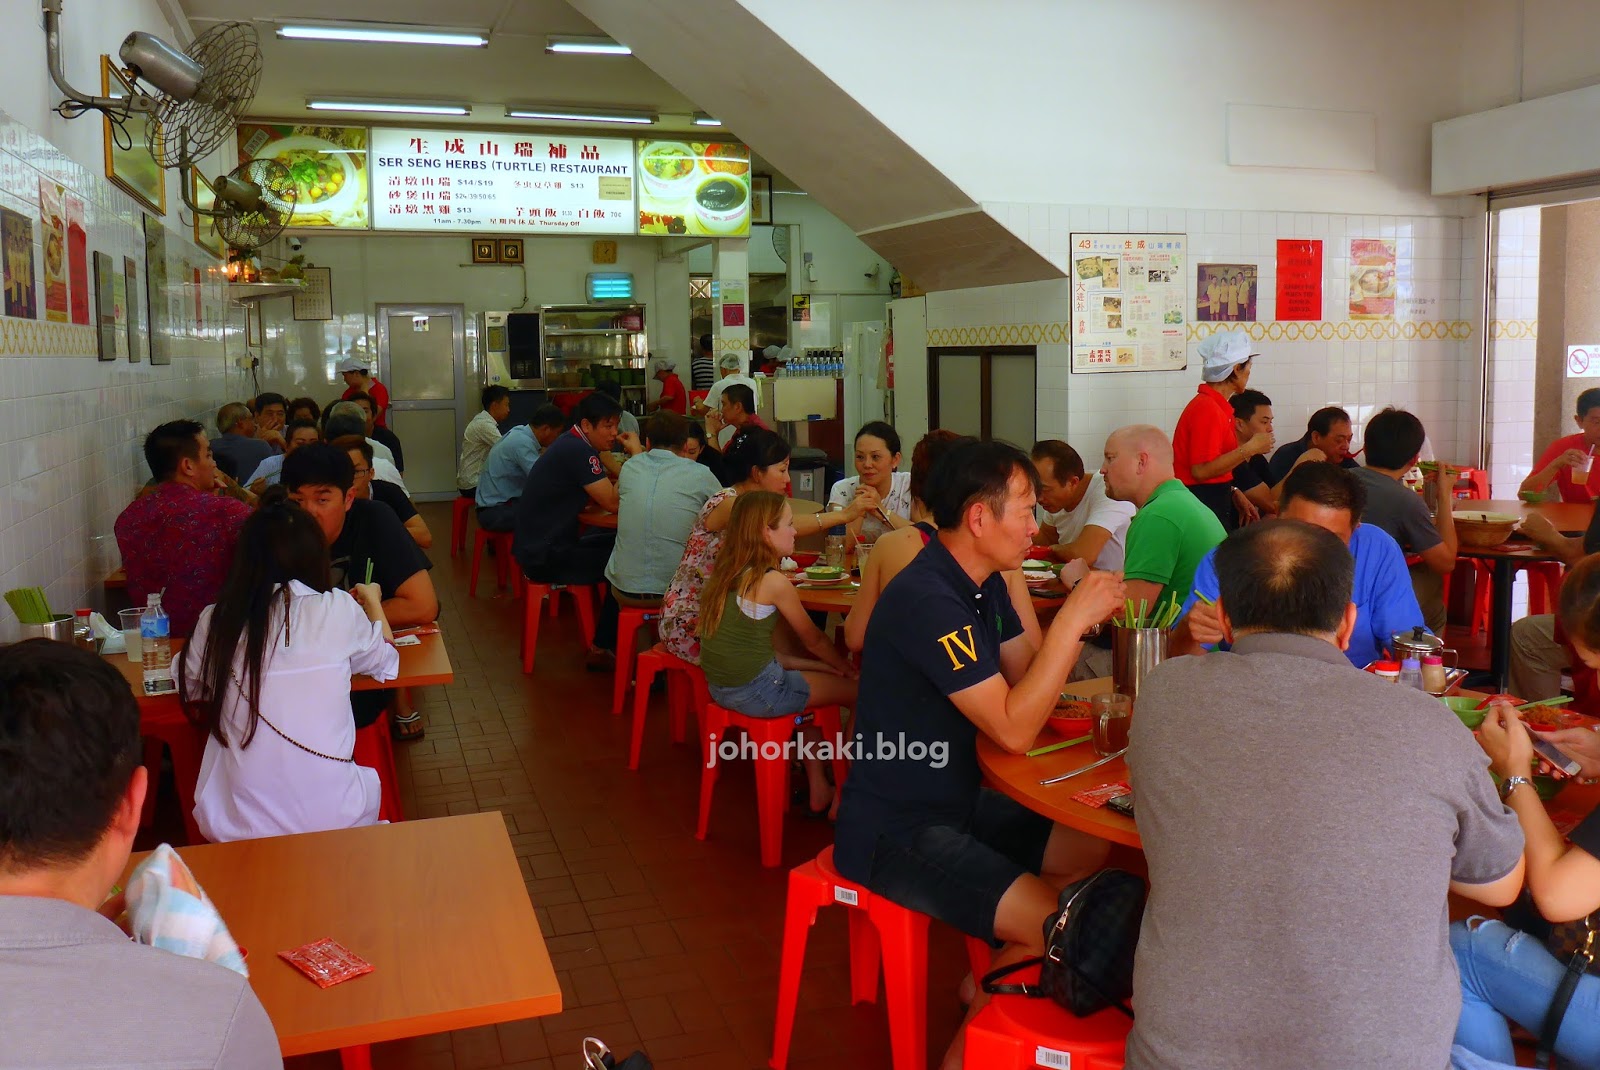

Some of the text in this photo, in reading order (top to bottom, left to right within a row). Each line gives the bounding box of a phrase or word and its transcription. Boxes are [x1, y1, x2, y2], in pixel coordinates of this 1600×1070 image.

[378, 157, 628, 175] SER SENG HERBS (TURTLE) RESTAURANT
[457, 218, 482, 226] 7.30pm
[539, 220, 569, 228] Thursday
[1079, 240, 1091, 249] 43
[588, 455, 603, 475] 3
[937, 624, 979, 671] IV
